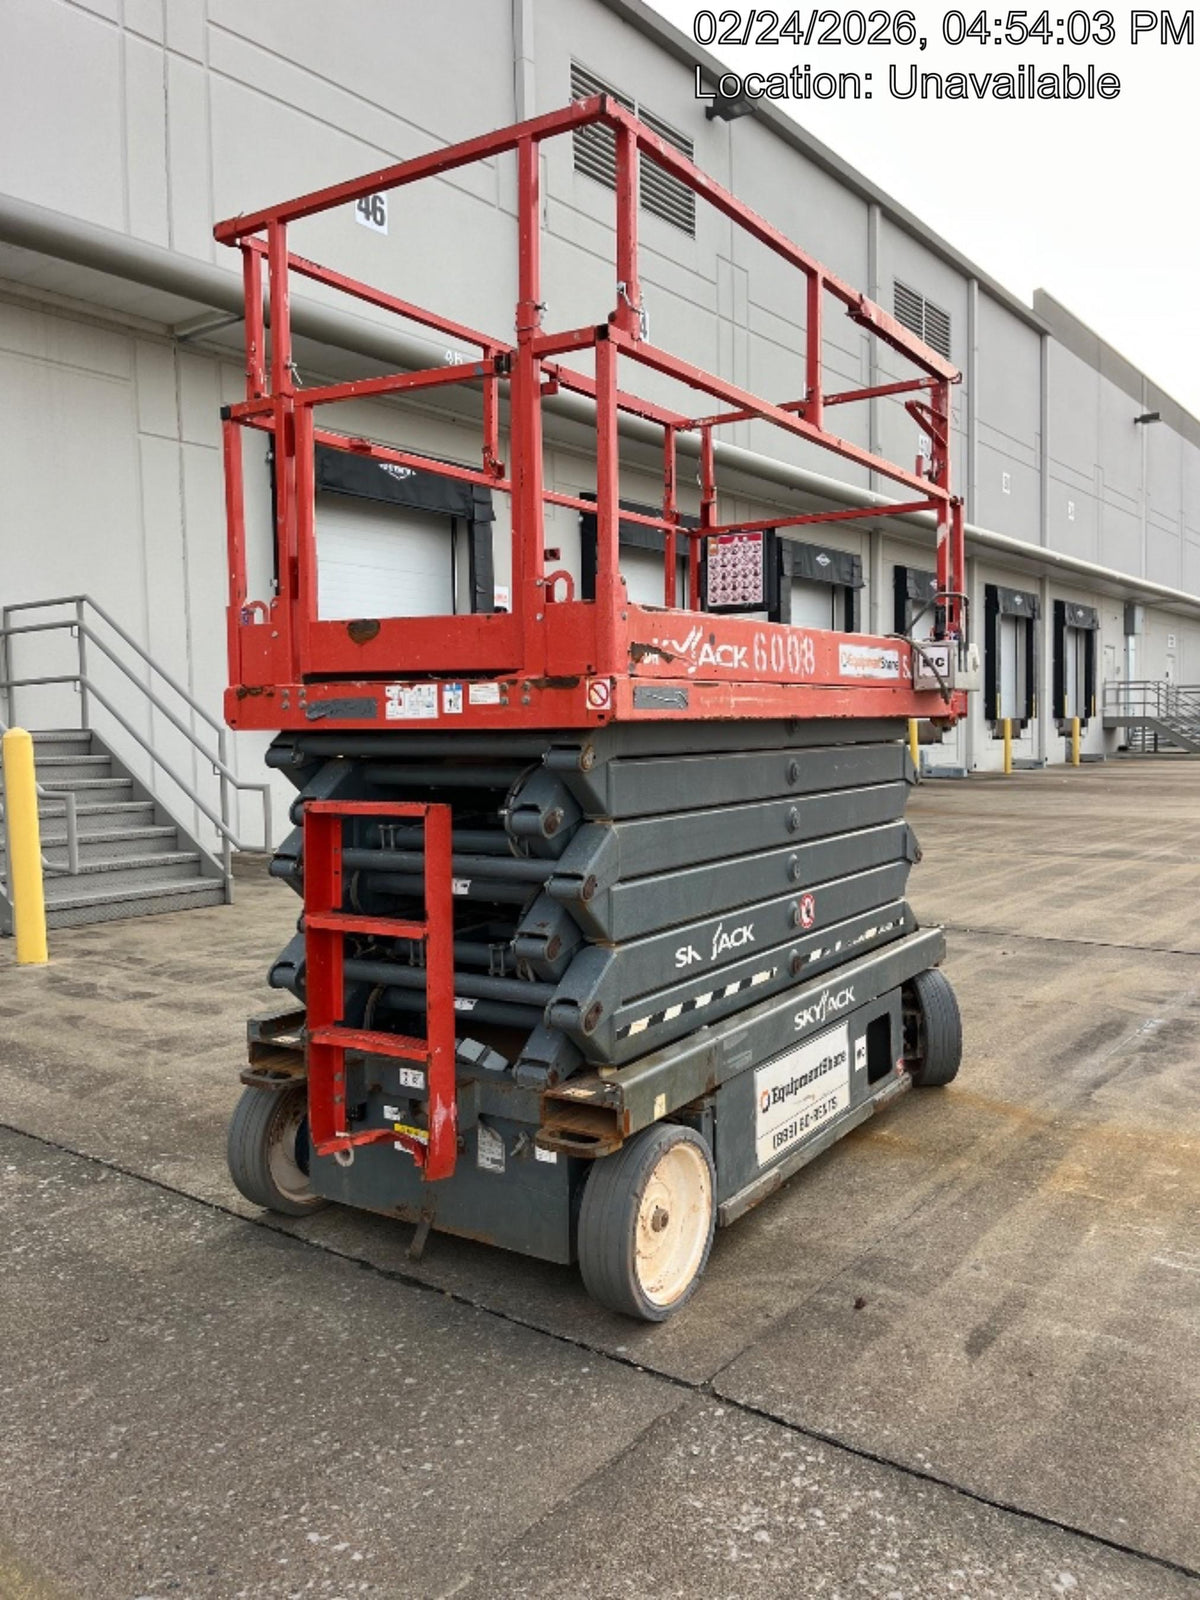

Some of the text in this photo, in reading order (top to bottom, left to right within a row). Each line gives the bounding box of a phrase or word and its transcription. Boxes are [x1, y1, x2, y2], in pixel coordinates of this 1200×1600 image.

[357, 195, 386, 226] 46
[675, 922, 755, 968] SKJACK
[794, 986, 856, 1031] SKYJACK
[772, 1050, 846, 1105] EquipmentShare
